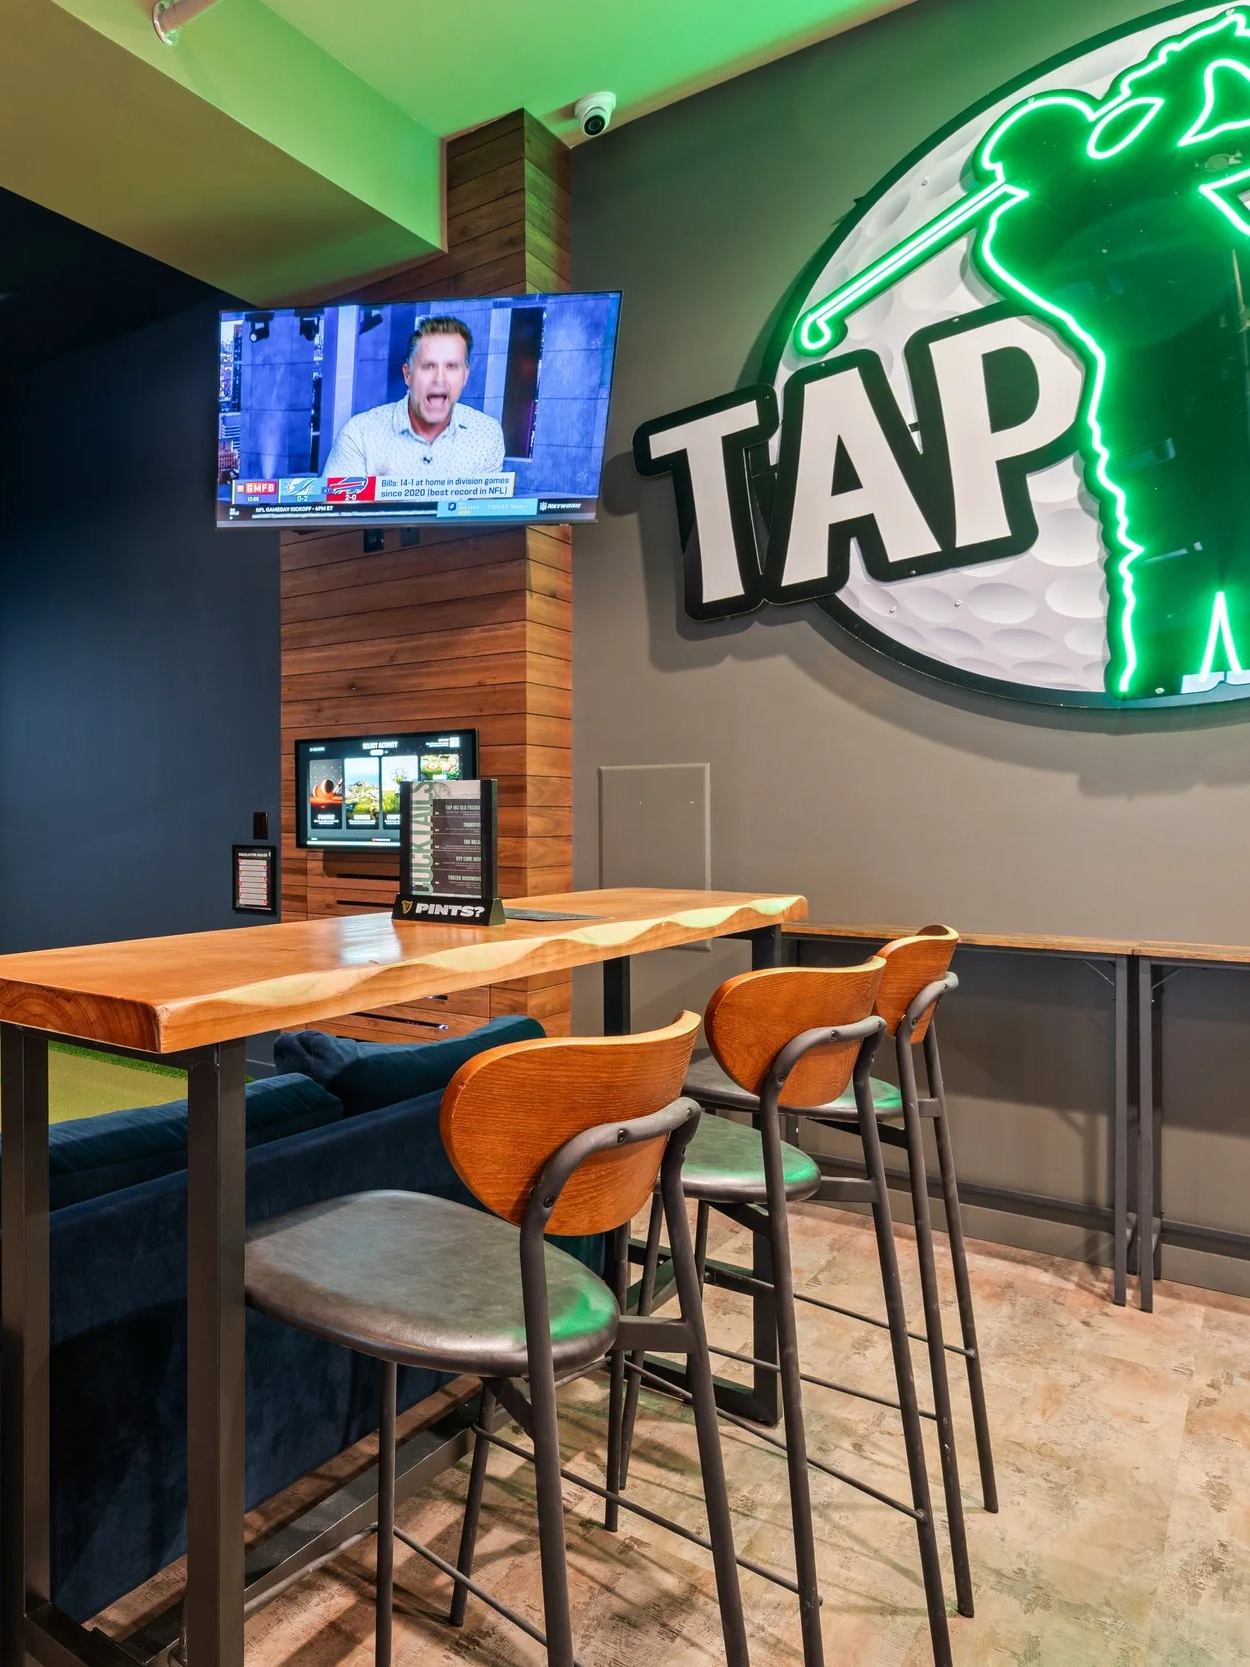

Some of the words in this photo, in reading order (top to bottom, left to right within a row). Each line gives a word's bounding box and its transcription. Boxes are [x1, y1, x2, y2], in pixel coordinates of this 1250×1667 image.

[649, 313, 1082, 603] TAP
[246, 482, 274, 493] GMFB
[425, 478, 445, 486] home
[484, 478, 509, 486] games
[381, 490, 402, 498] since
[404, 489, 425, 497] 2020
[427, 488, 448, 497] (best
[450, 487, 478, 496] record
[480, 487, 486, 495] in
[488, 486, 508, 495] NFL)
[362, 742, 378, 750] SELECT
[378, 741, 398, 749] ACTIVITY
[416, 903, 485, 917] PINTS?
